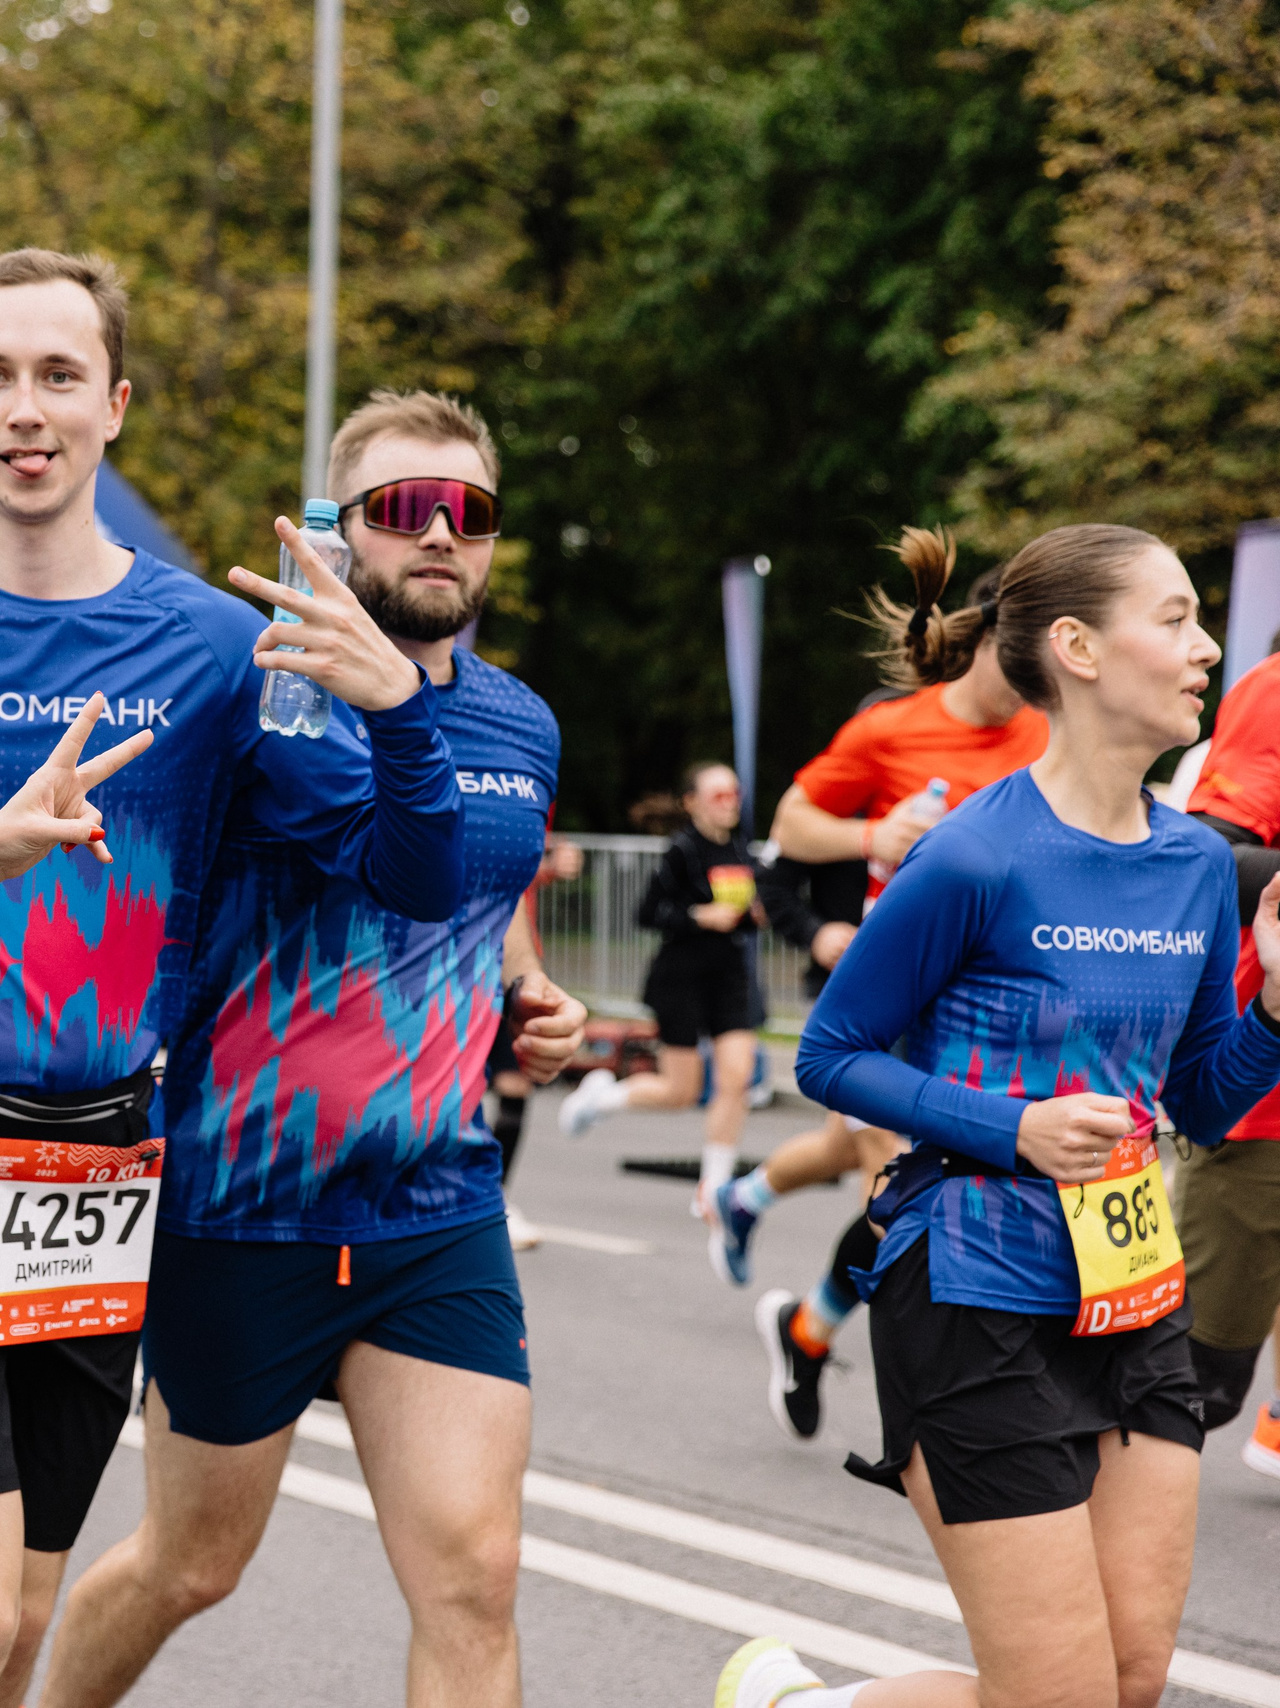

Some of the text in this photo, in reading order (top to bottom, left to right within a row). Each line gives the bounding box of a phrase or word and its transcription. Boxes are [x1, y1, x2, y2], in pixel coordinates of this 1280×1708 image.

[456, 771, 538, 802] БАНК
[1031, 924, 1206, 955] СОВКОМБАНК
[86, 1167, 111, 1182] 10
[1103, 1178, 1158, 1248] 885
[15, 1254, 92, 1282] ДМИТРИЙ
[1088, 1300, 1111, 1333] D
